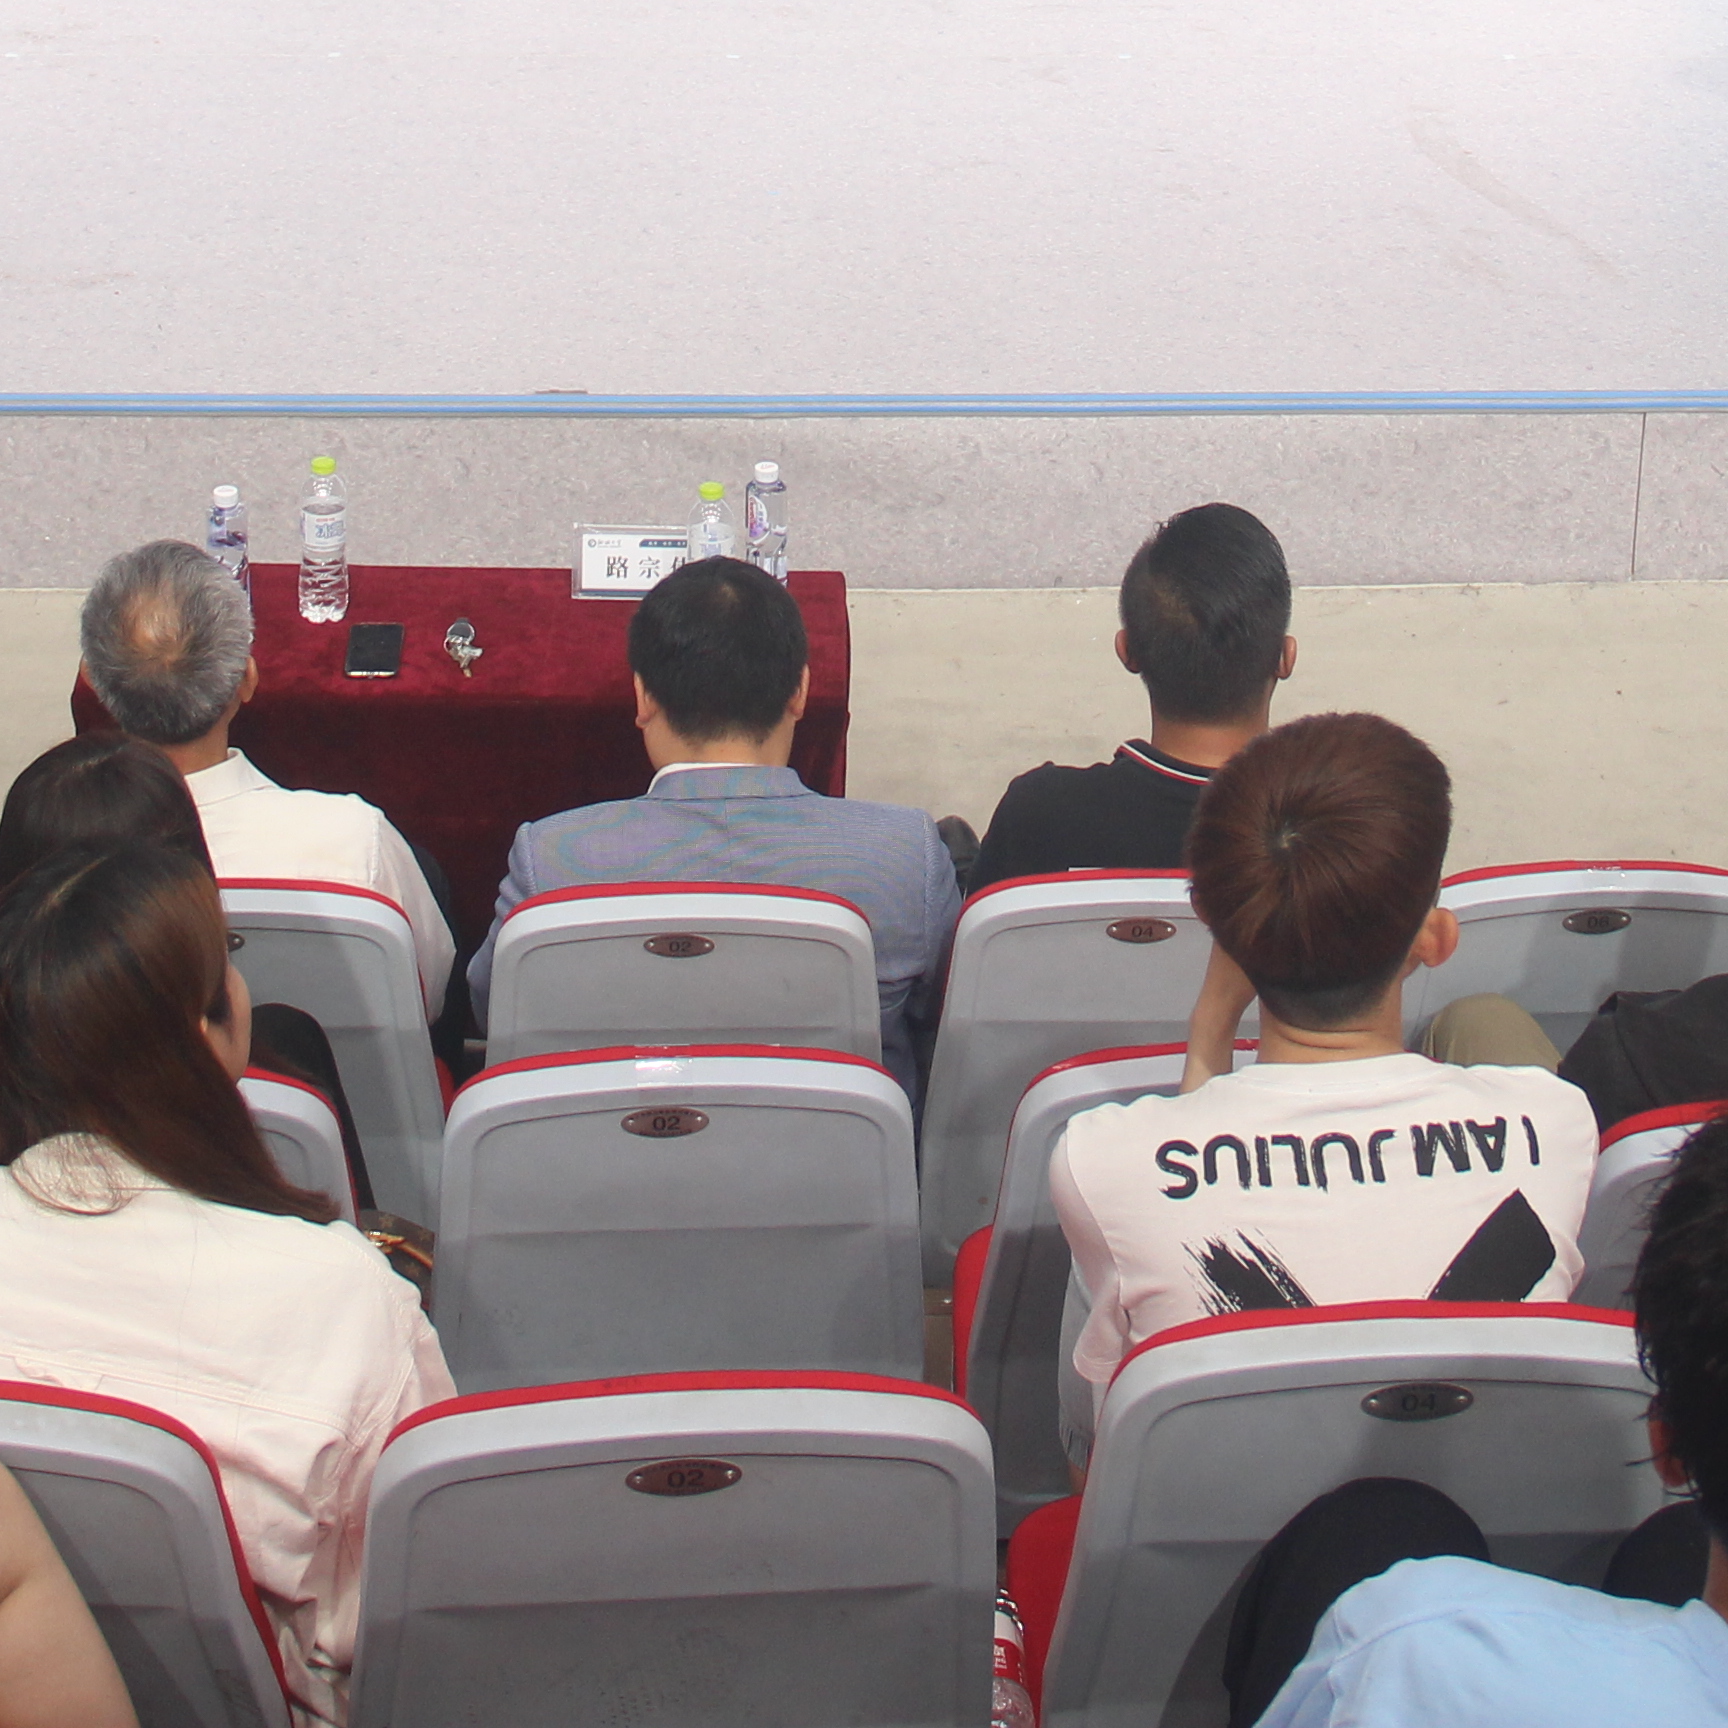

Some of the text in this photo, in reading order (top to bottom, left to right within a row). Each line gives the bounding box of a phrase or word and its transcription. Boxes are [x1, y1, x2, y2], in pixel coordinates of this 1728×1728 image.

[668, 940, 692, 953] 02
[651, 1114, 681, 1131] 02
[1154, 1114, 1541, 1201] I AM JULIUS
[666, 1468, 707, 1488] 02
